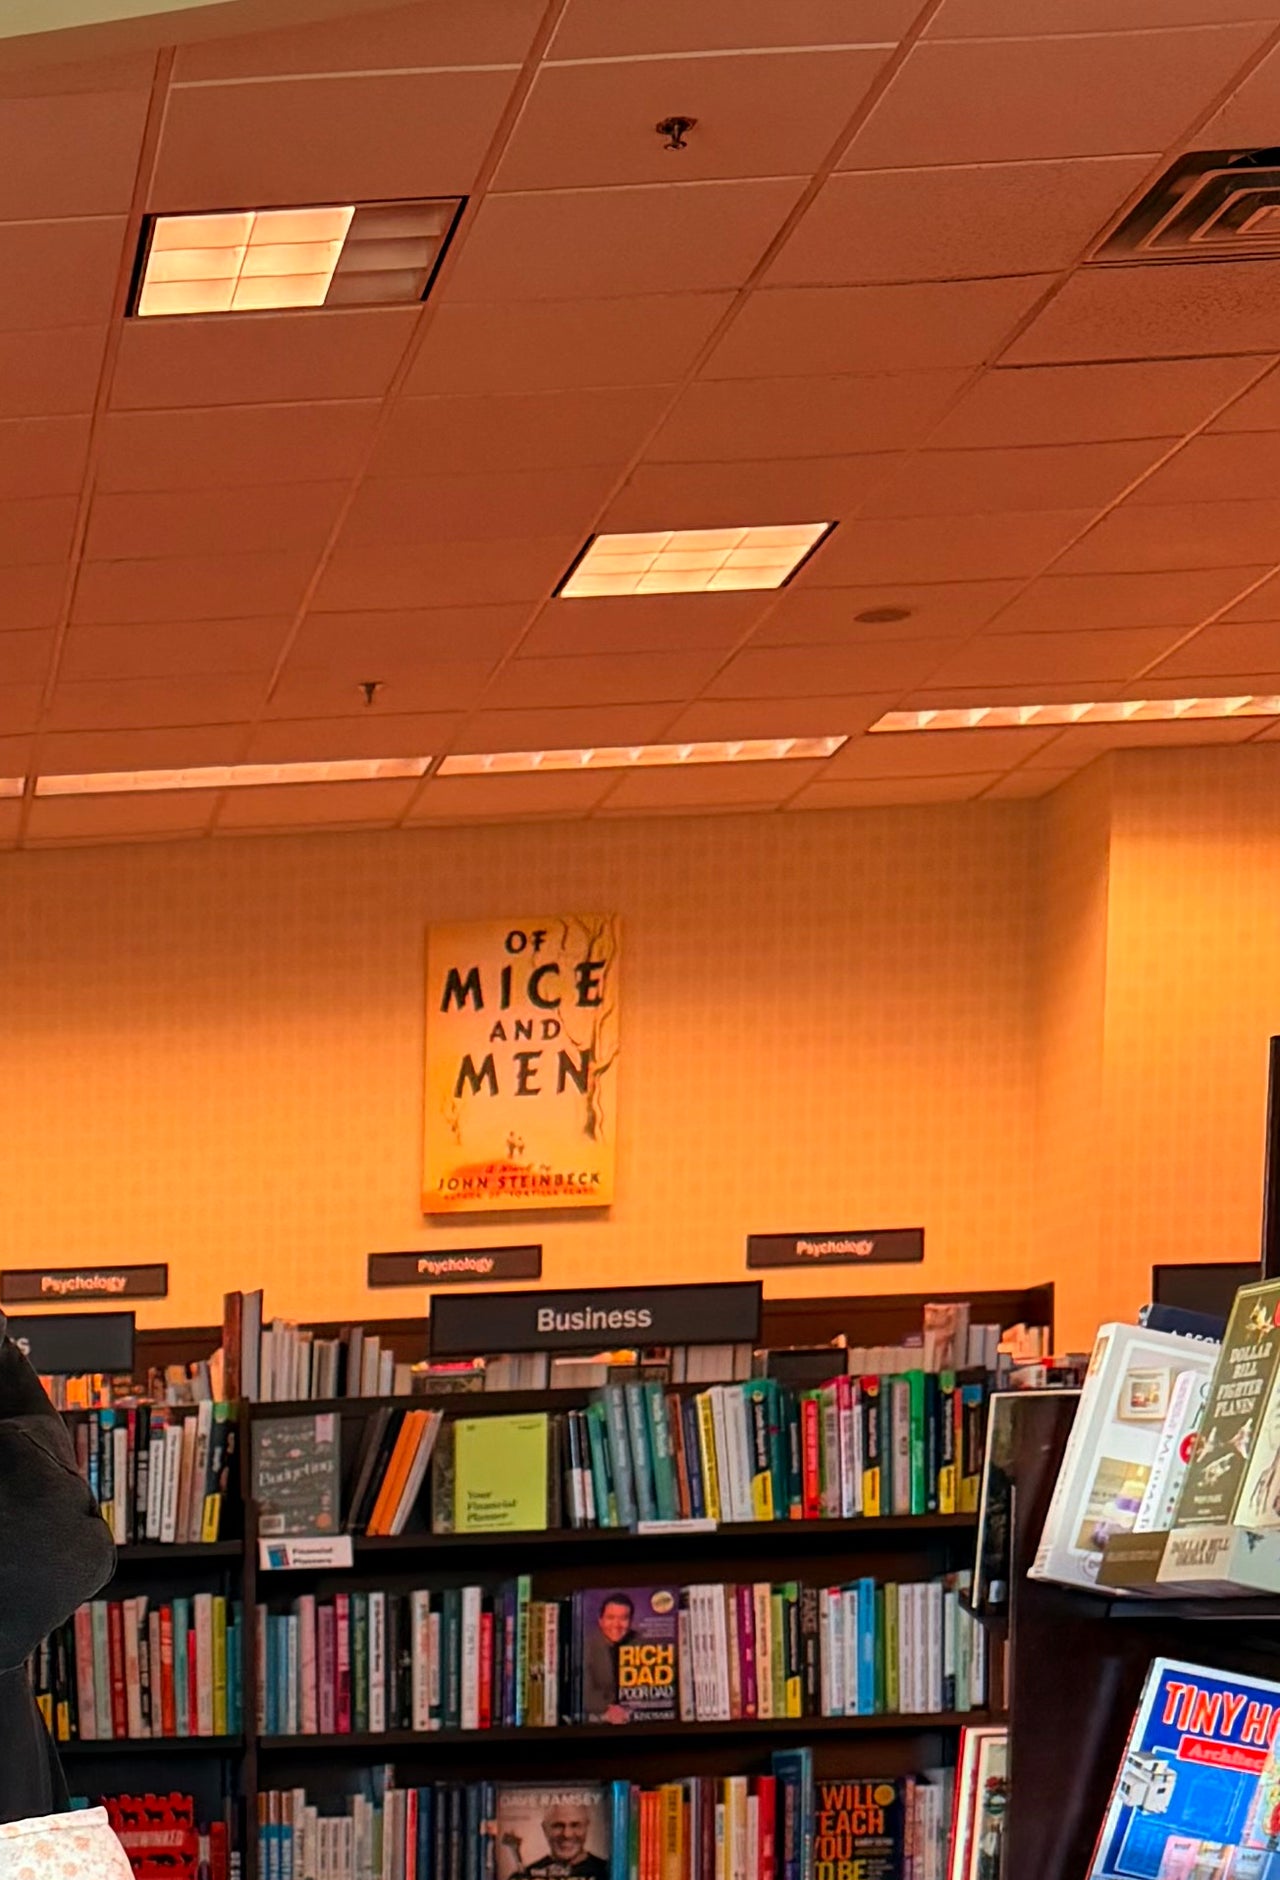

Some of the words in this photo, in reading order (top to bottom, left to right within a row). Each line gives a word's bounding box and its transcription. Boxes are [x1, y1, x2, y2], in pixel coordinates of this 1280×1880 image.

[504, 930, 547, 954] OF
[440, 960, 606, 1013] MICE
[489, 1018, 561, 1042] AND
[454, 1049, 592, 1099] MEN
[498, 1173, 600, 1189] STEINBECK
[797, 1239, 873, 1257] Psychology
[418, 1257, 493, 1275] Psychology
[41, 1274, 126, 1293] Psychology
[537, 1305, 652, 1333] Business
[619, 1644, 674, 1666] RICH
[619, 1665, 674, 1687] DAD
[1162, 1681, 1246, 1736] TINY
[822, 1785, 876, 1810] WILL
